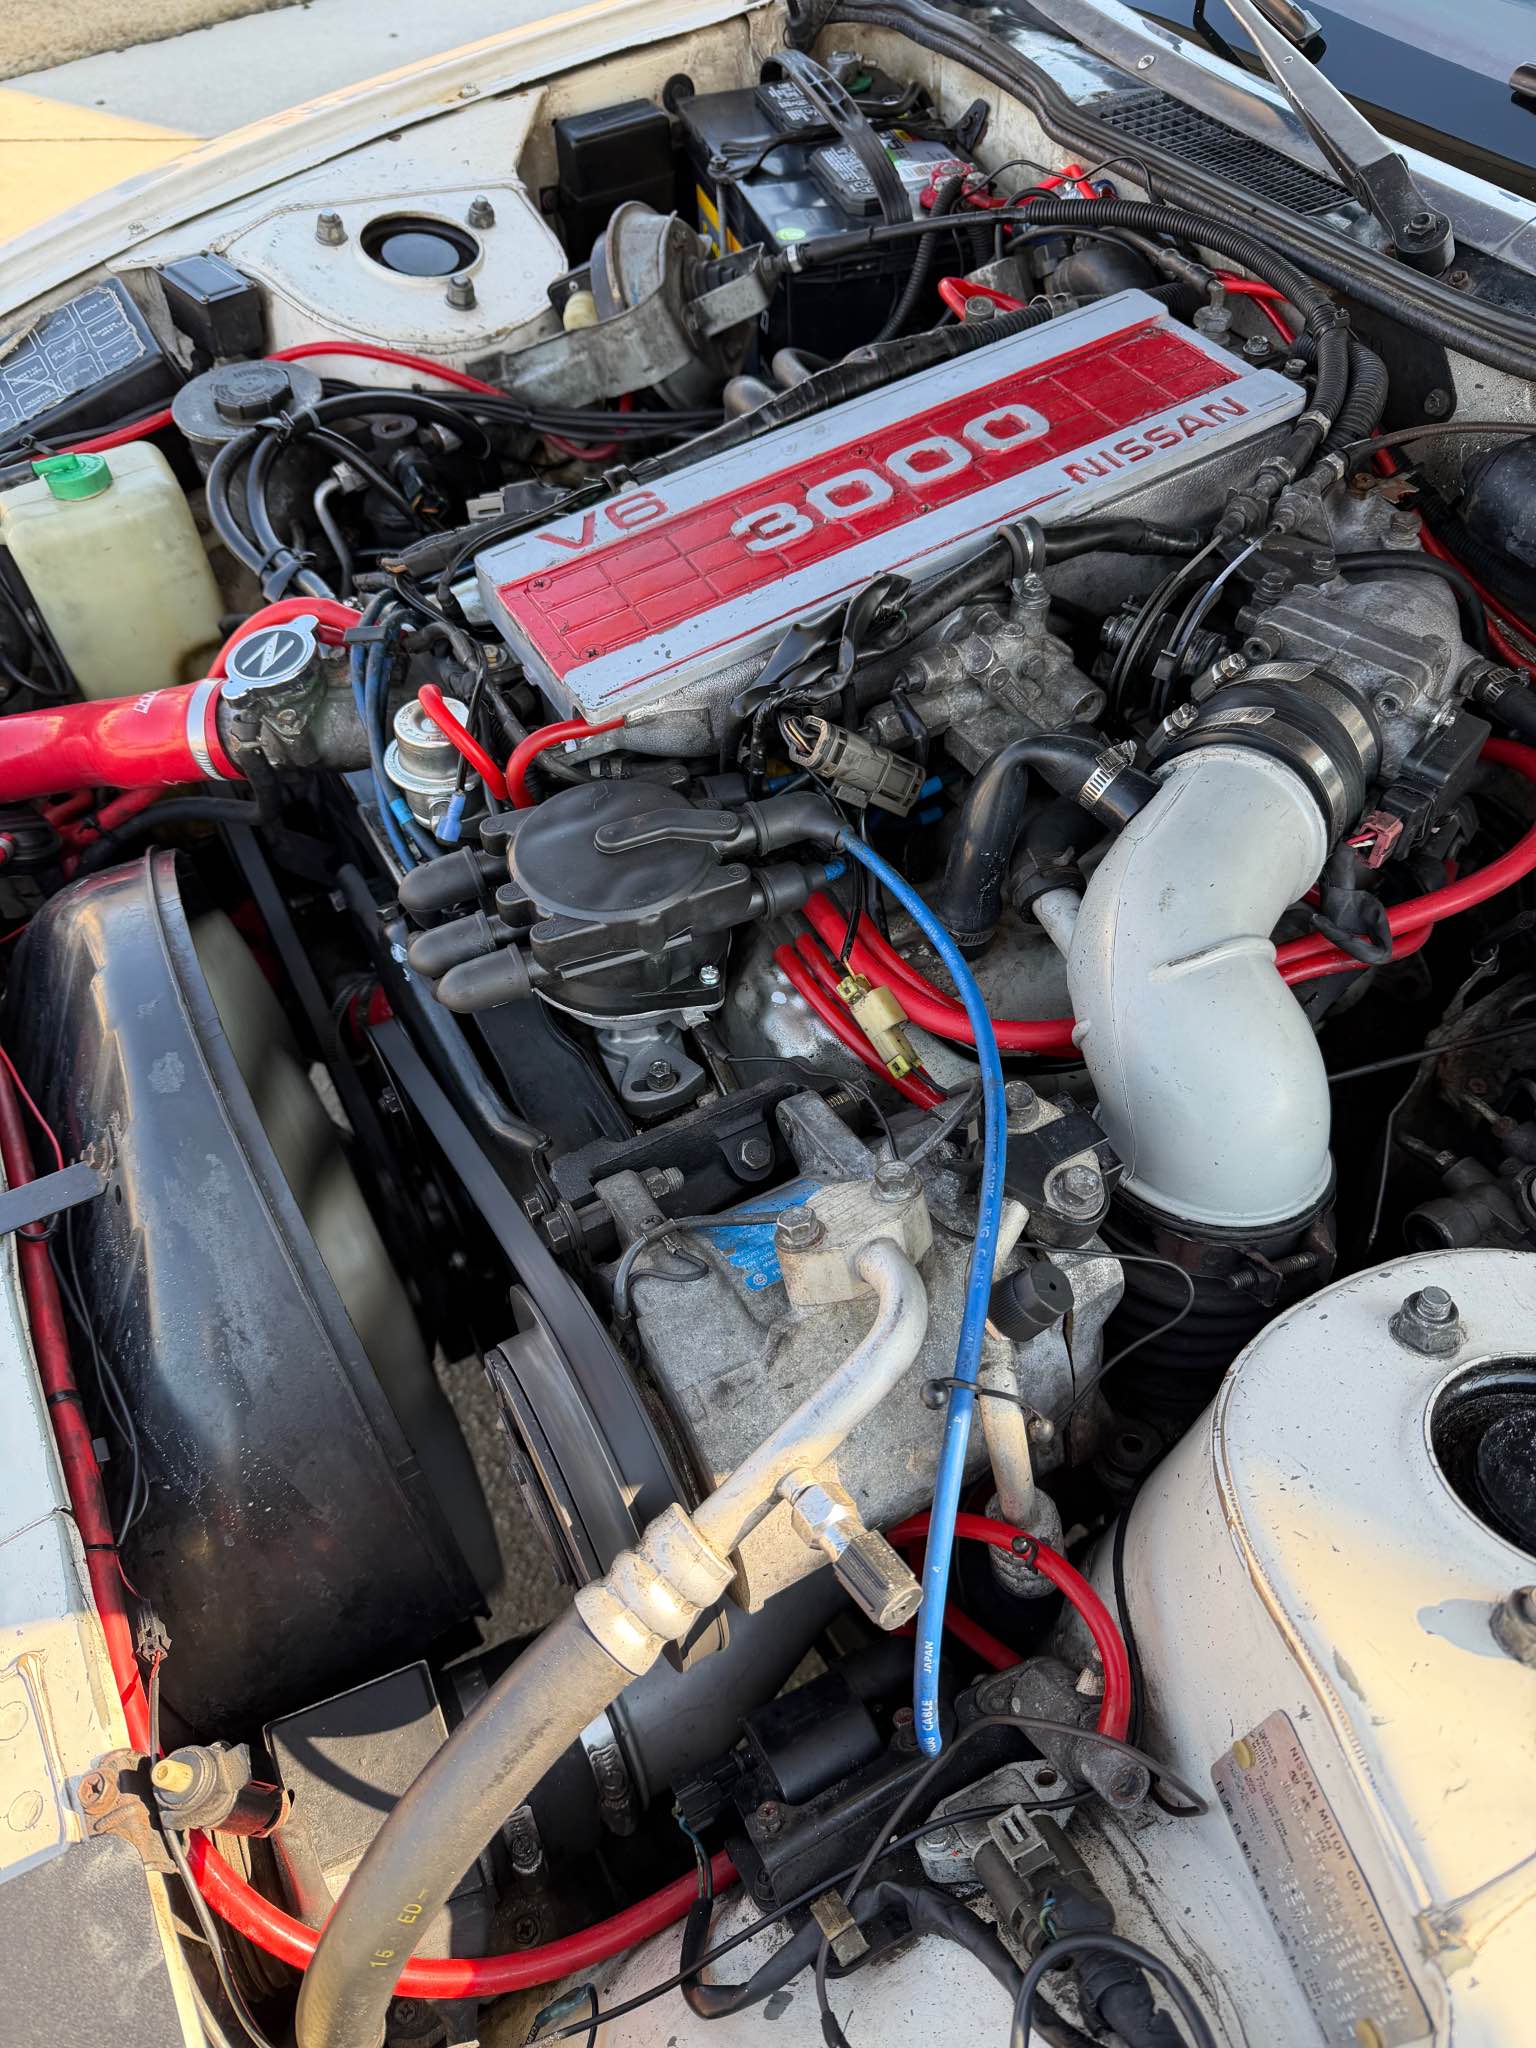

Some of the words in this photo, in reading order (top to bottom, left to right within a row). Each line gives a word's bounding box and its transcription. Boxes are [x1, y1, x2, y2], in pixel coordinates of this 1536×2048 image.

[1062, 396, 1250, 484] NISSAN
[730, 403, 1050, 556] 3000
[535, 490, 670, 549] V6
[923, 1640, 935, 1674] JAPAN
[920, 1699, 934, 1732] CABLE
[1288, 1746, 1321, 1801] NISSAN
[1317, 1808, 1348, 1861] MOTOR
